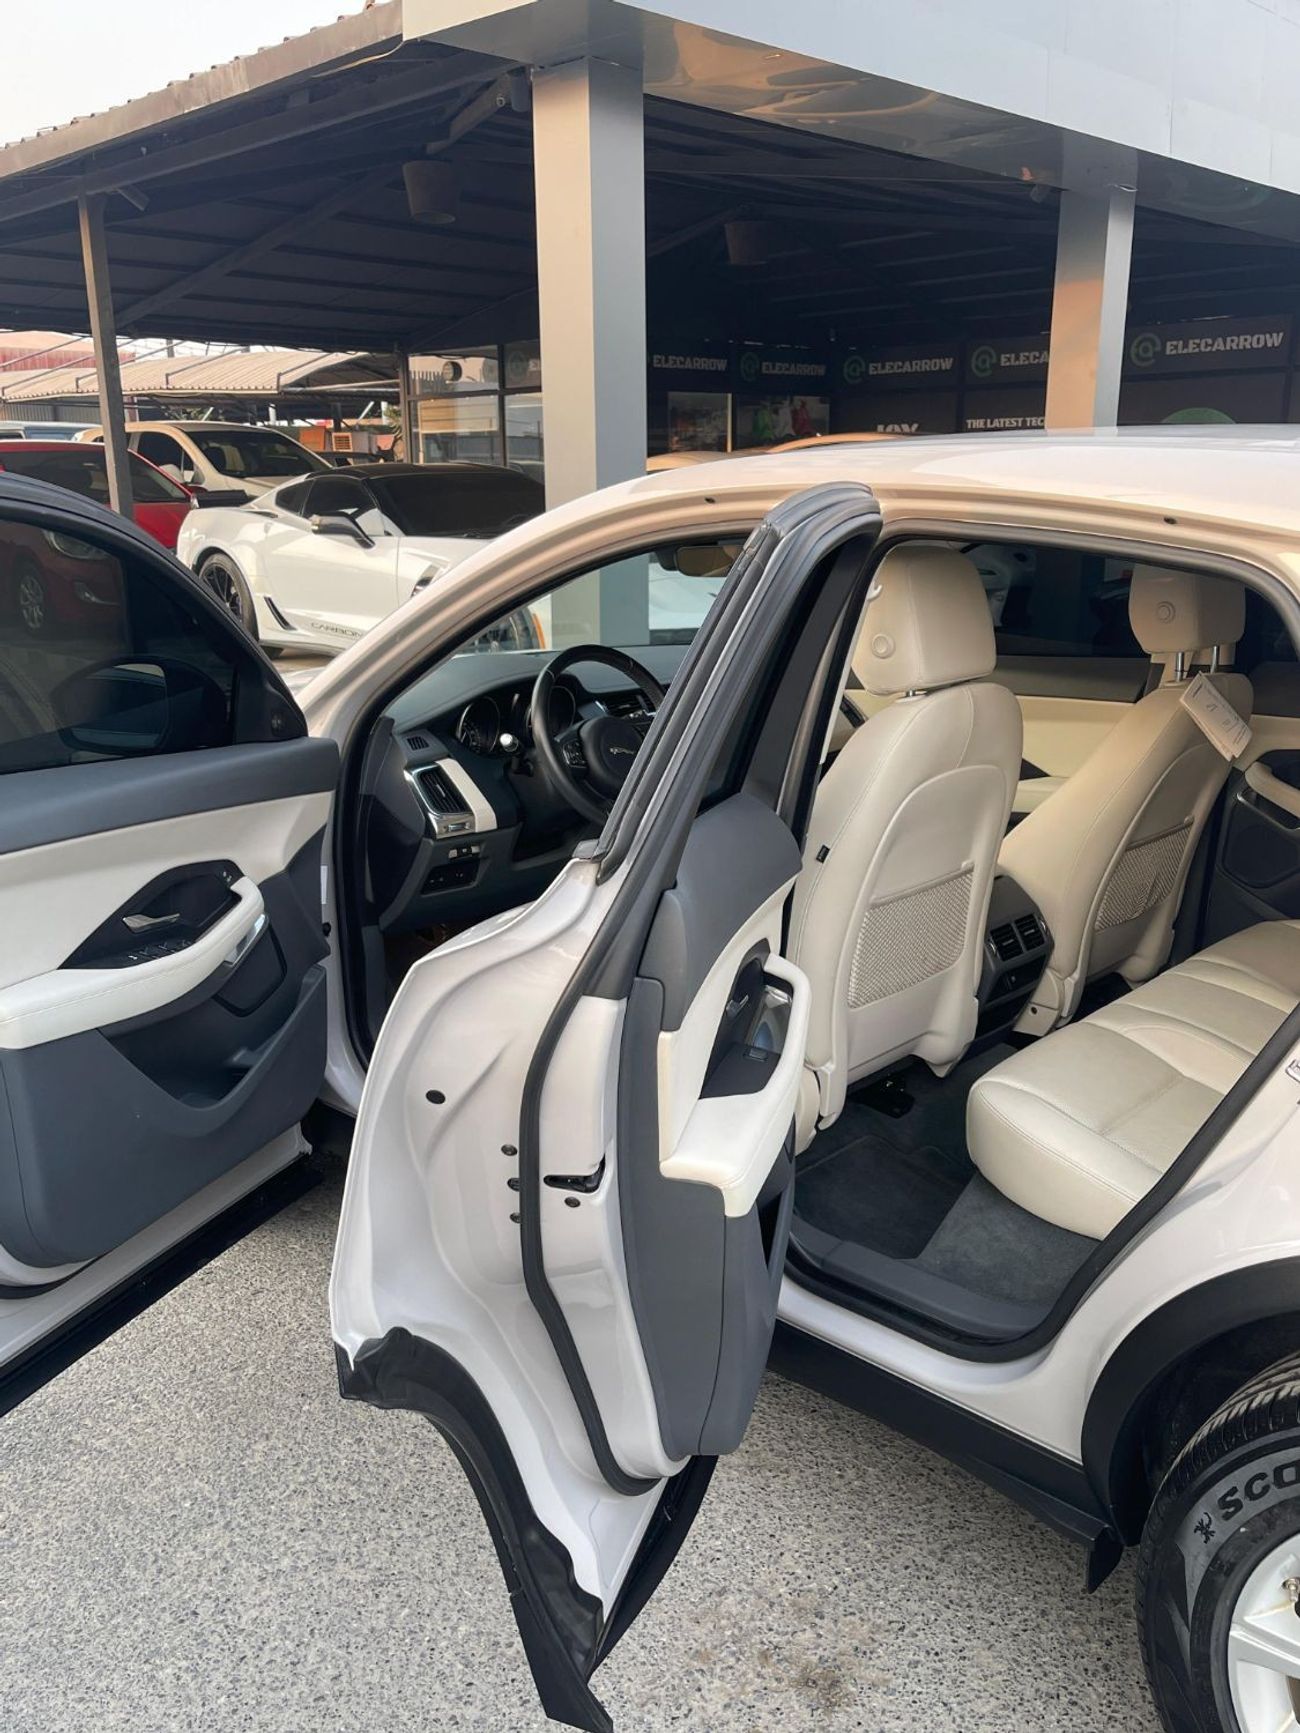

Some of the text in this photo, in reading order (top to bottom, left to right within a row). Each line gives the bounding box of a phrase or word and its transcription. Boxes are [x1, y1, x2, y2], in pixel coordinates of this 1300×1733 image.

[1165, 332, 1284, 355] ELECARROW
[652, 354, 728, 371] ELECARROW
[761, 361, 826, 377] ELECARROW
[868, 357, 954, 376] ELECARROW
[966, 418, 985, 429] THE
[986, 417, 1023, 428] LATEST
